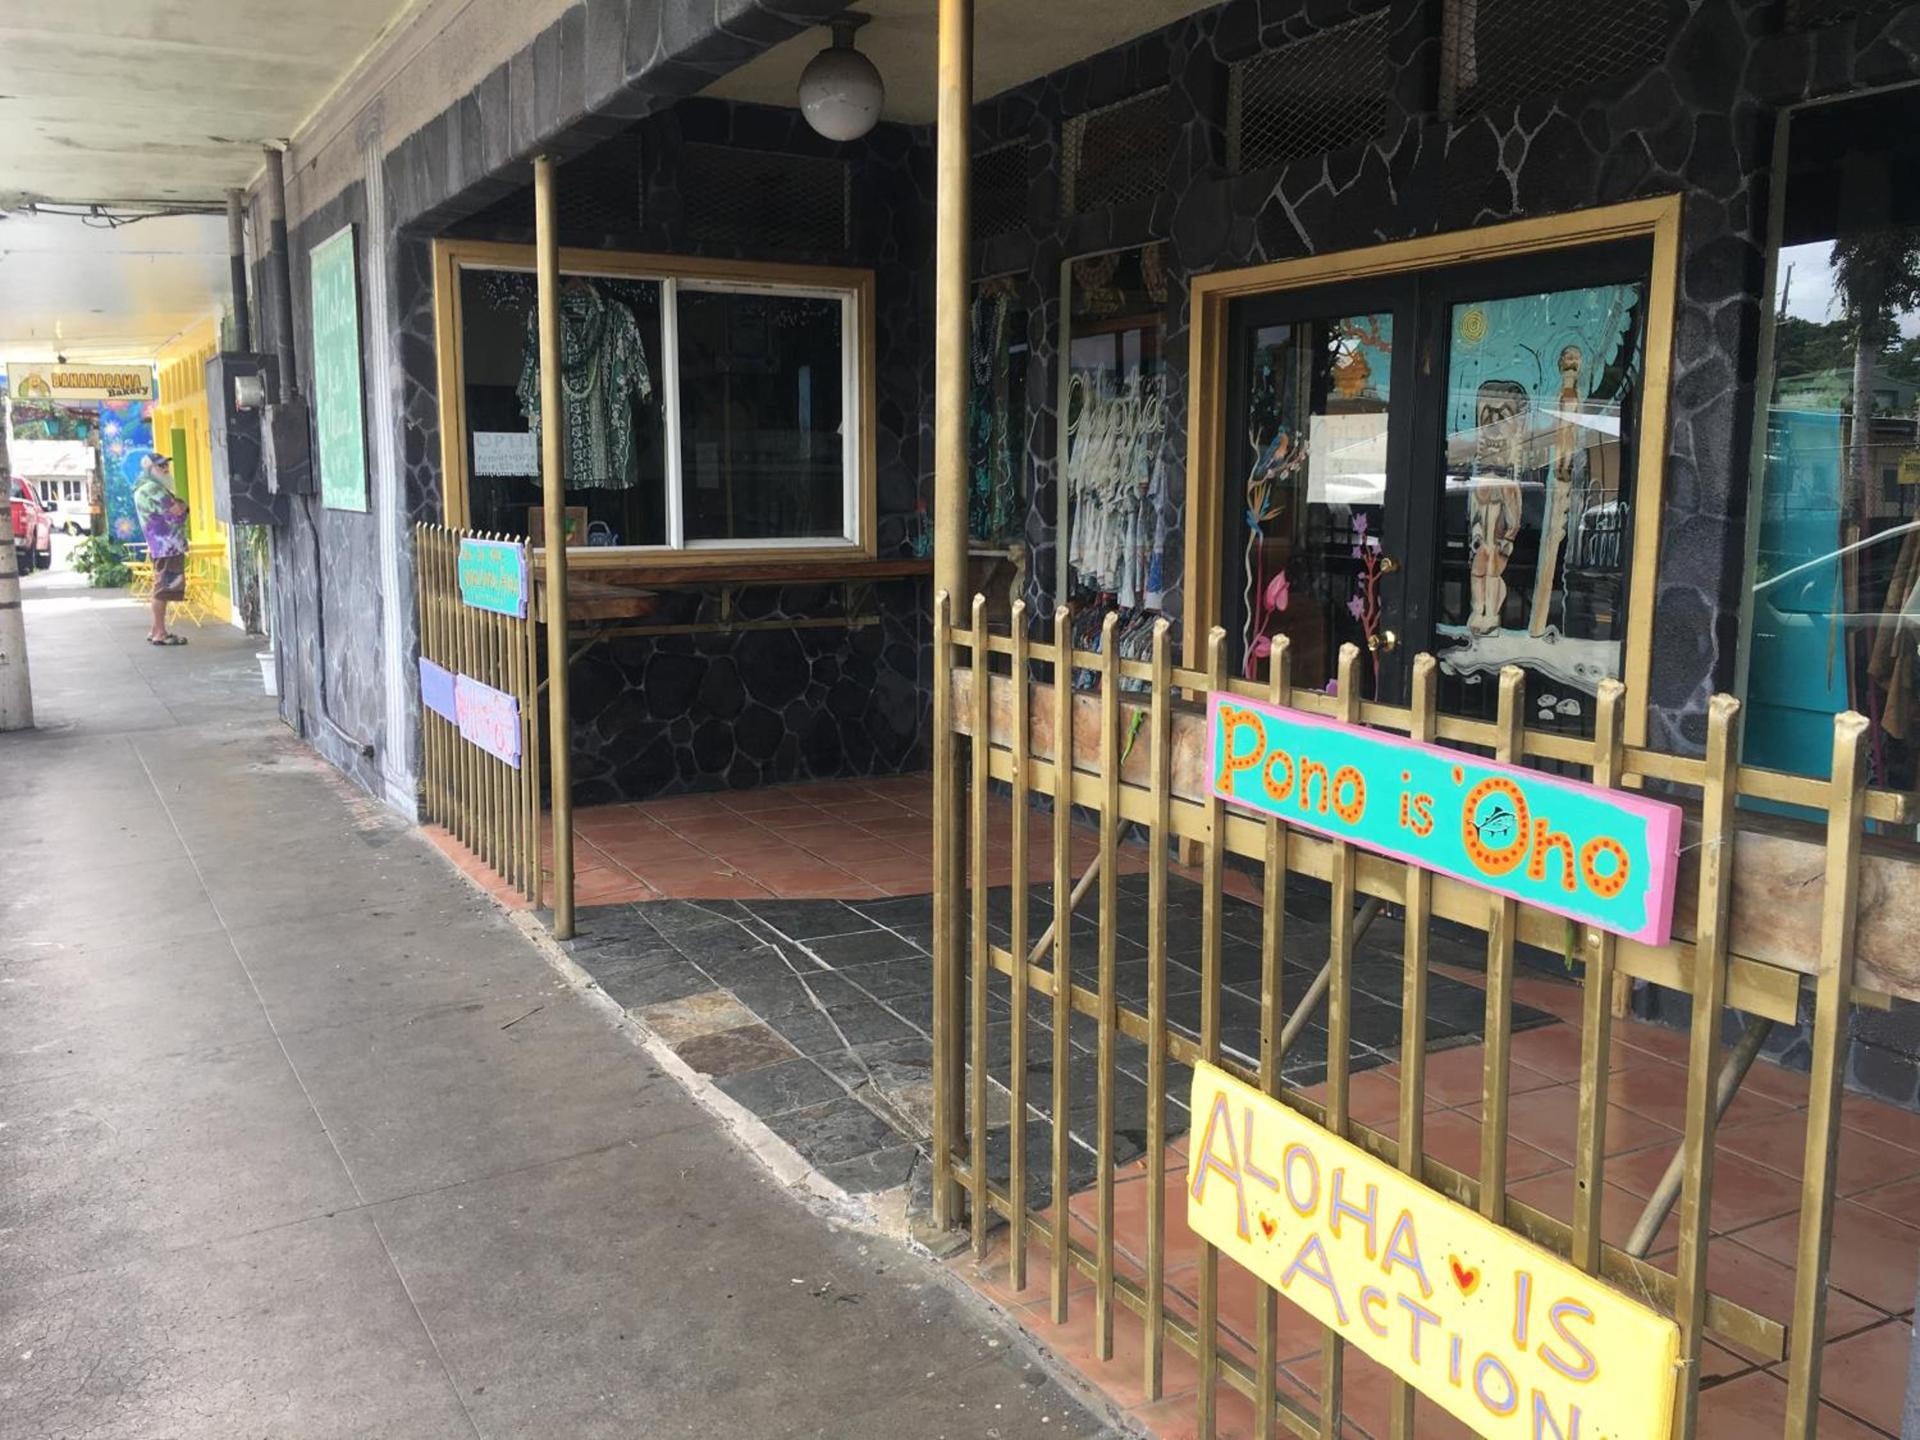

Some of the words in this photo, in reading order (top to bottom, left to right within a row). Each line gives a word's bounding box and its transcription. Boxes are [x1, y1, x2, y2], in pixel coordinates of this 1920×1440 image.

[51, 373, 142, 388] BANANARAMA
[107, 386, 149, 397] Bakery
[1214, 705, 1366, 825] Pono
[1398, 771, 1434, 837] is
[1190, 1090, 1434, 1299] ALOHA
[1513, 1270, 1599, 1383] IS
[1279, 1233, 1583, 1440] ACTION
